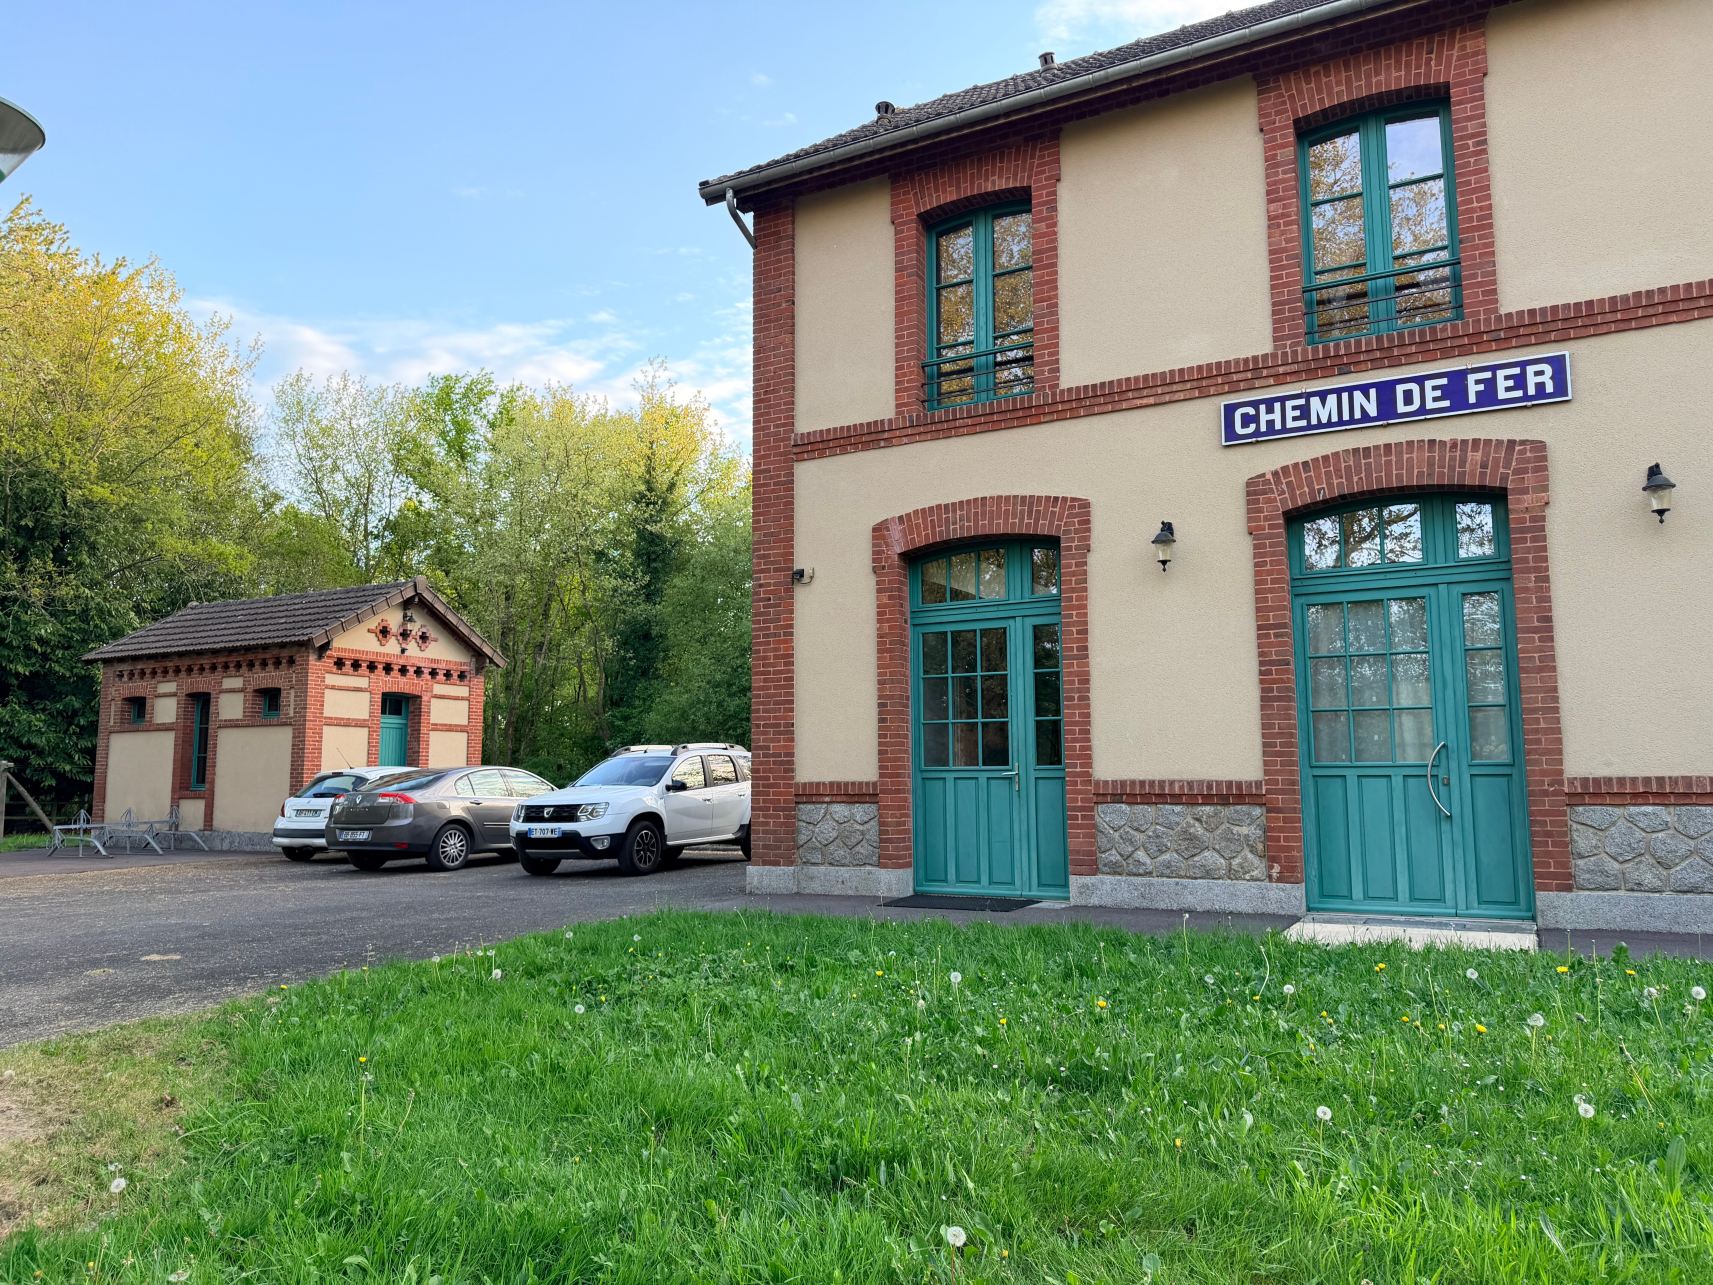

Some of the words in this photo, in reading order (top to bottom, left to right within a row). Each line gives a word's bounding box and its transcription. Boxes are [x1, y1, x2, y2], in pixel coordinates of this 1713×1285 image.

[1233, 387, 1378, 436] CHEMIN
[1395, 377, 1451, 414] DE
[1466, 363, 1555, 404] FER
